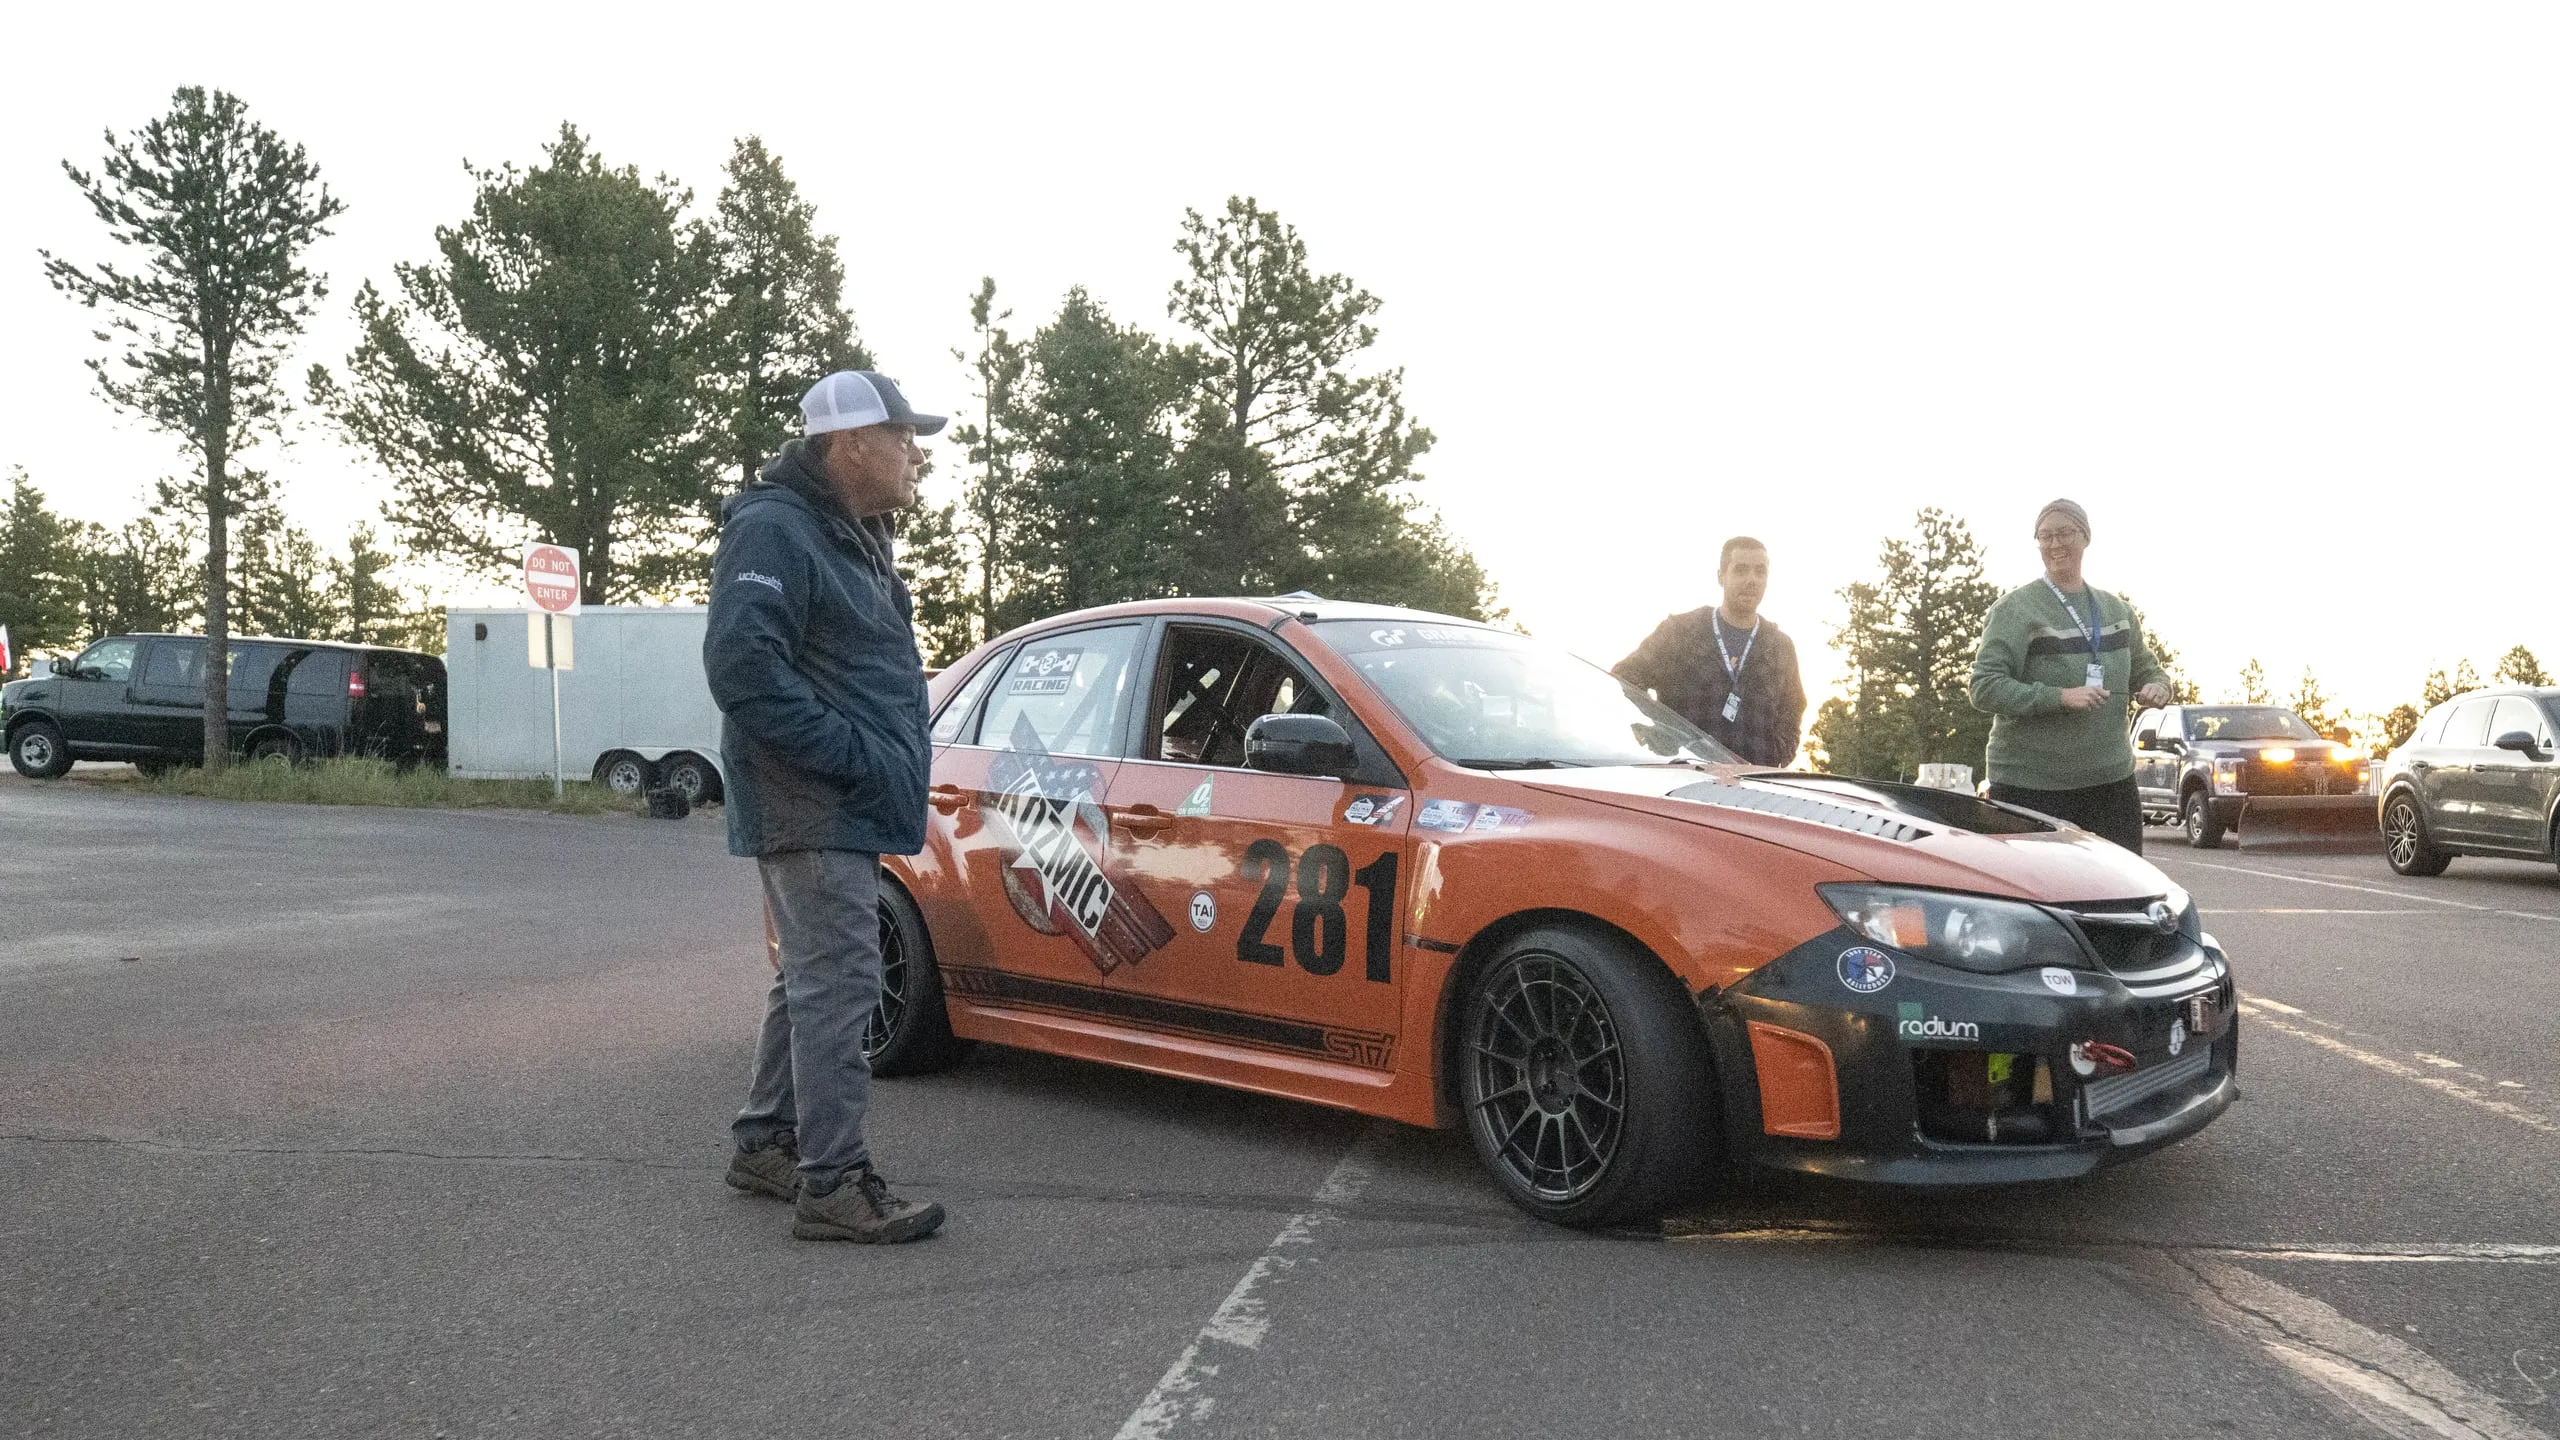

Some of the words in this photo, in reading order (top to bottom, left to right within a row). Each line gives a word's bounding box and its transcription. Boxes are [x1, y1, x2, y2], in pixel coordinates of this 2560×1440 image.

[532, 556, 546, 569] DO
[551, 560, 571, 572] NOT
[738, 569, 783, 591] uchealth
[537, 586, 568, 601] ENTER
[1012, 679, 1066, 691] RACING
[1193, 903, 1213, 918] TAI
[1236, 838, 1398, 984] 281
[2044, 974, 2072, 985] TOW
[1899, 1015, 1979, 1037] radium
